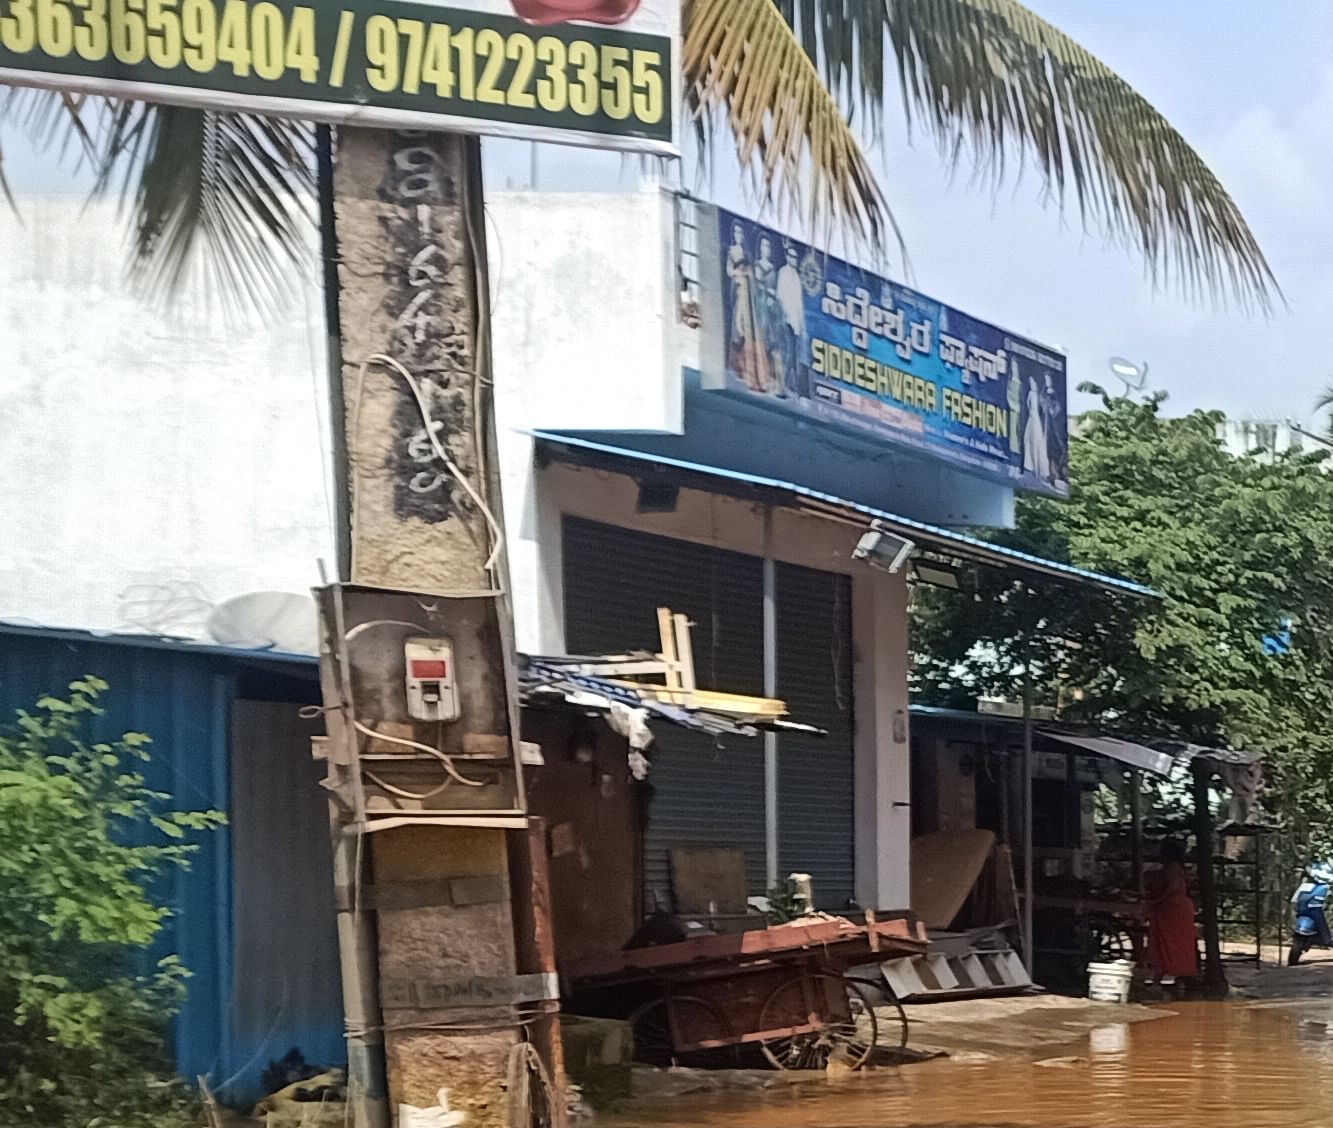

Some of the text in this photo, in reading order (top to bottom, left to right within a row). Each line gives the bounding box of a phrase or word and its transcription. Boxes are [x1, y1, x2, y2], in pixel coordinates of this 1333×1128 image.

[328, 9, 353, 88] /
[364, 14, 664, 124] 9741223355
[812, 338, 936, 412] SIDDESHWARA
[941, 387, 1009, 439] FASHION
